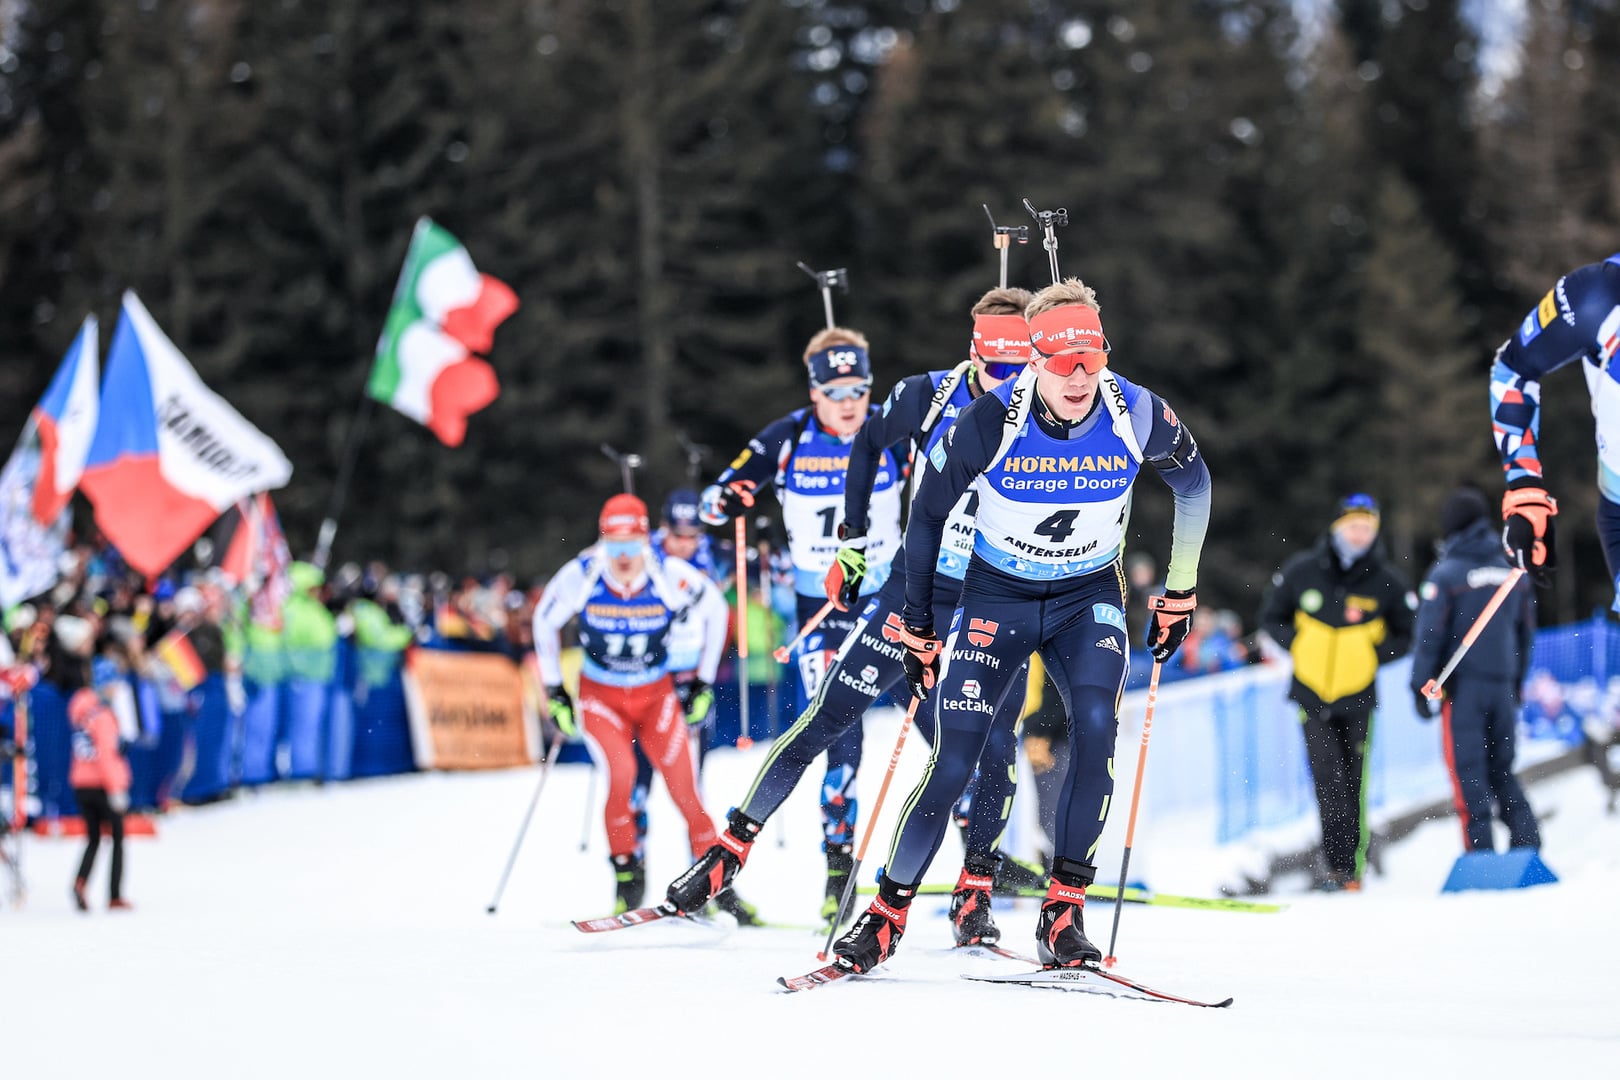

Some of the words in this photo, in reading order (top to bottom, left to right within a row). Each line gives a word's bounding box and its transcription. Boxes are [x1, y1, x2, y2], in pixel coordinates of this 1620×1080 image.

[933, 376, 955, 407] JOKA
[1103, 378, 1129, 416] JOKA
[1004, 386, 1026, 427] JOKA
[1003, 455, 1128, 473] HÖRMANN
[1001, 476, 1068, 493] Garage
[1074, 476, 1128, 491] Doors
[1033, 509, 1081, 543] 4
[1004, 536, 1098, 558] ANTERSELVA
[1095, 642, 1122, 655] adidas
[951, 649, 1001, 670] WÜRTH
[943, 698, 994, 716] tectake
